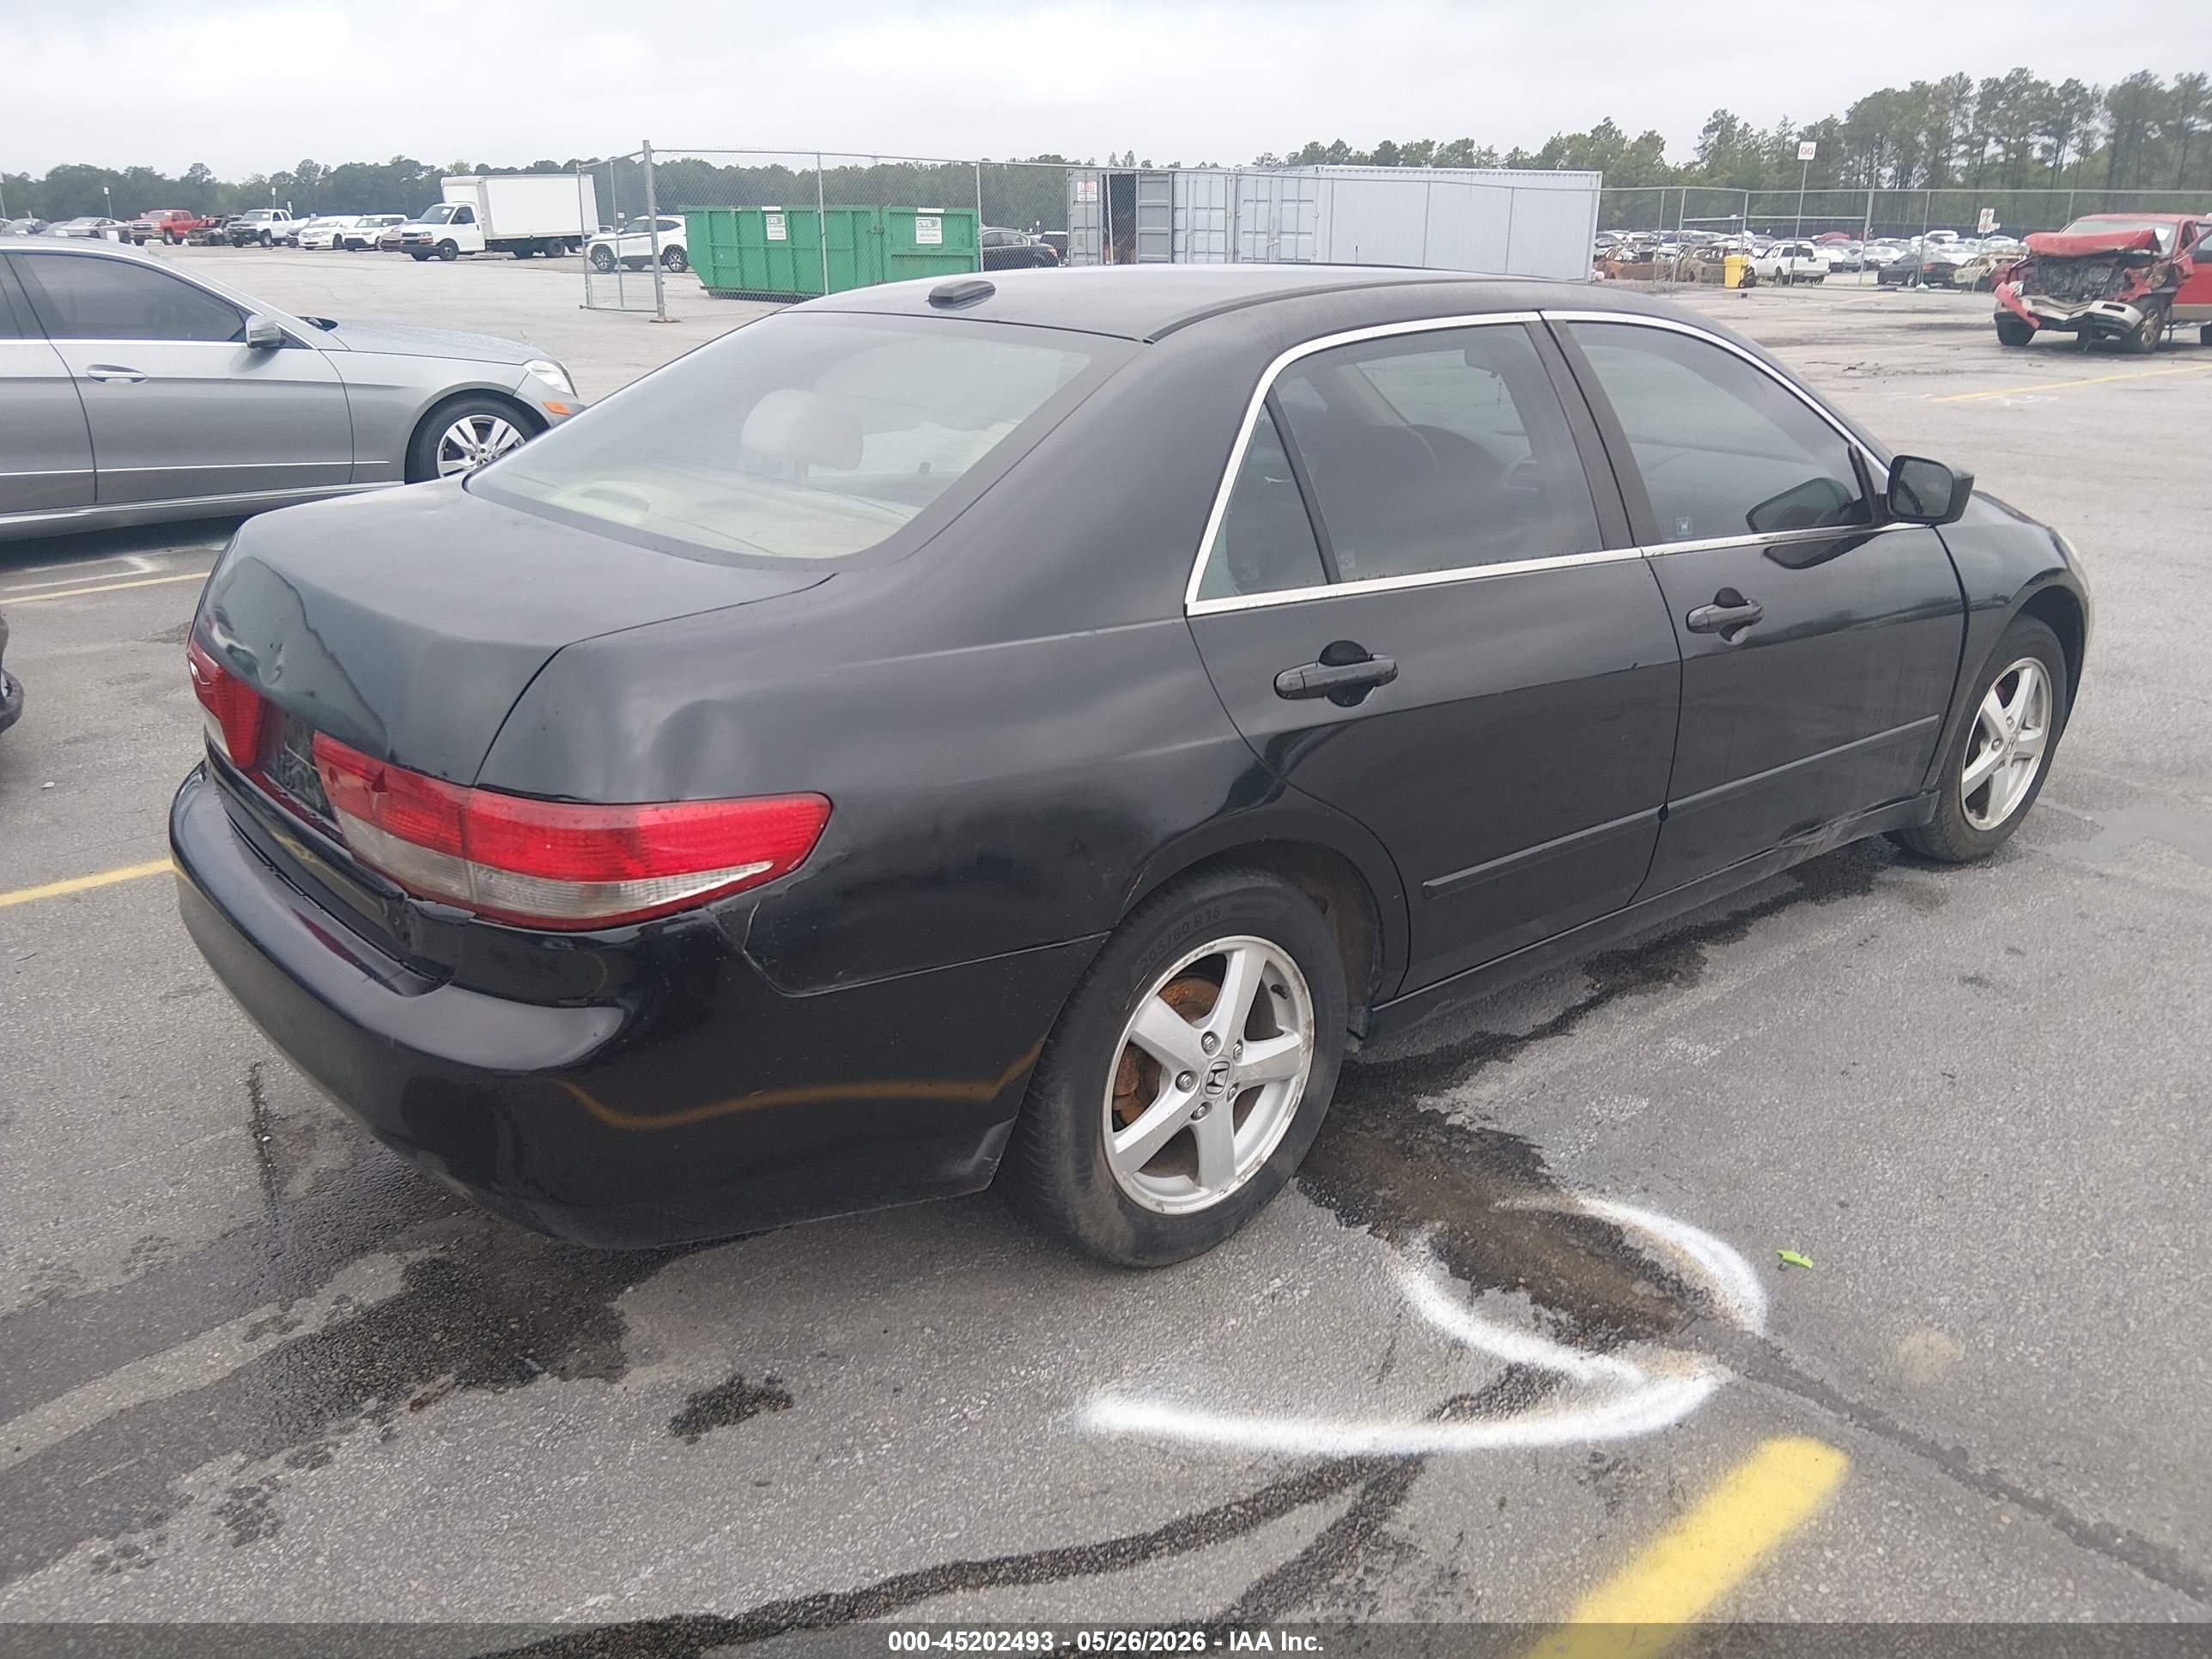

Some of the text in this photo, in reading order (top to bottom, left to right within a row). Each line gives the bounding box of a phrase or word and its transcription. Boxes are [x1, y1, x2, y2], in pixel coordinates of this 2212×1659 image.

[1139, 905, 1221, 970] 205/60 R 16
